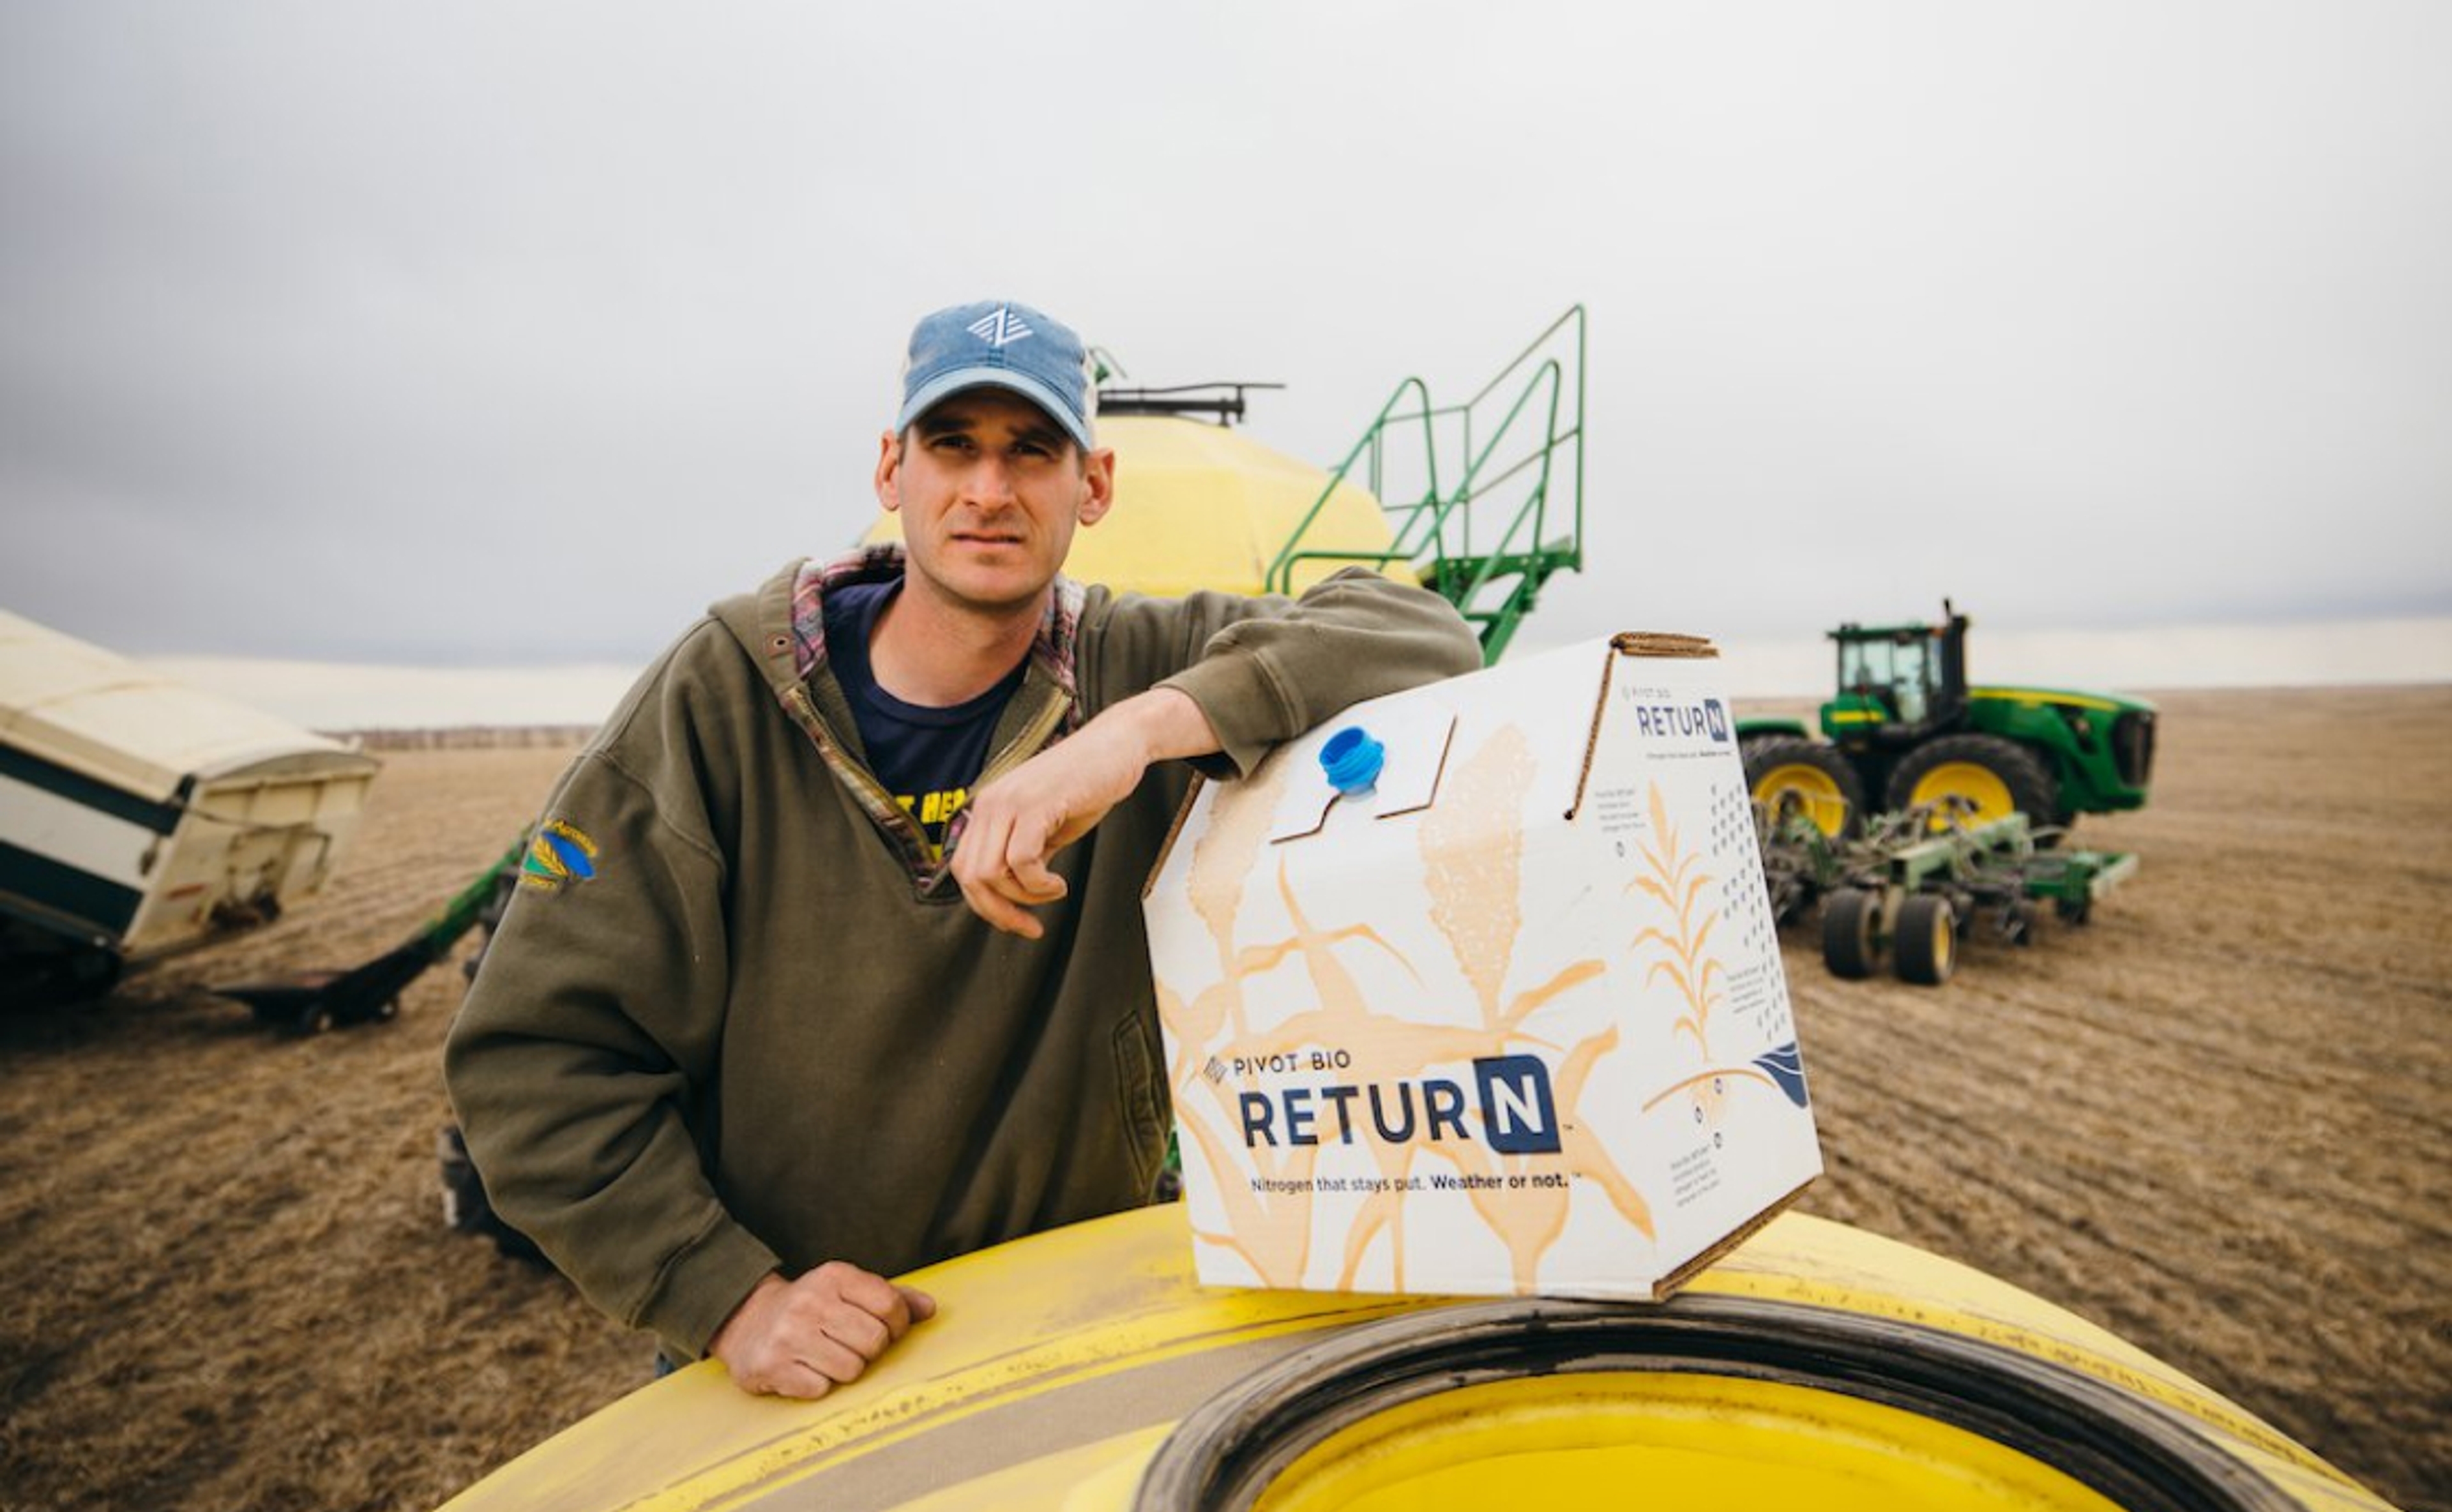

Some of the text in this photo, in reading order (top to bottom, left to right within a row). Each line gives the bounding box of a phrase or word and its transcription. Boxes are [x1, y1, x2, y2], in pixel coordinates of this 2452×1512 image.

[1636, 699, 1729, 741] RETURN
[1233, 1050, 1352, 1076] PIVOT BIO
[1239, 1055, 1562, 1154] RETURN
[1250, 1179, 1314, 1195] Nitrogen
[1317, 1178, 1347, 1191] that
[1351, 1178, 1391, 1196] stays
[1393, 1176, 1427, 1192] put.
[1431, 1172, 1502, 1190] Weather
[1508, 1176, 1527, 1189] or
[1531, 1172, 1569, 1189] not.
